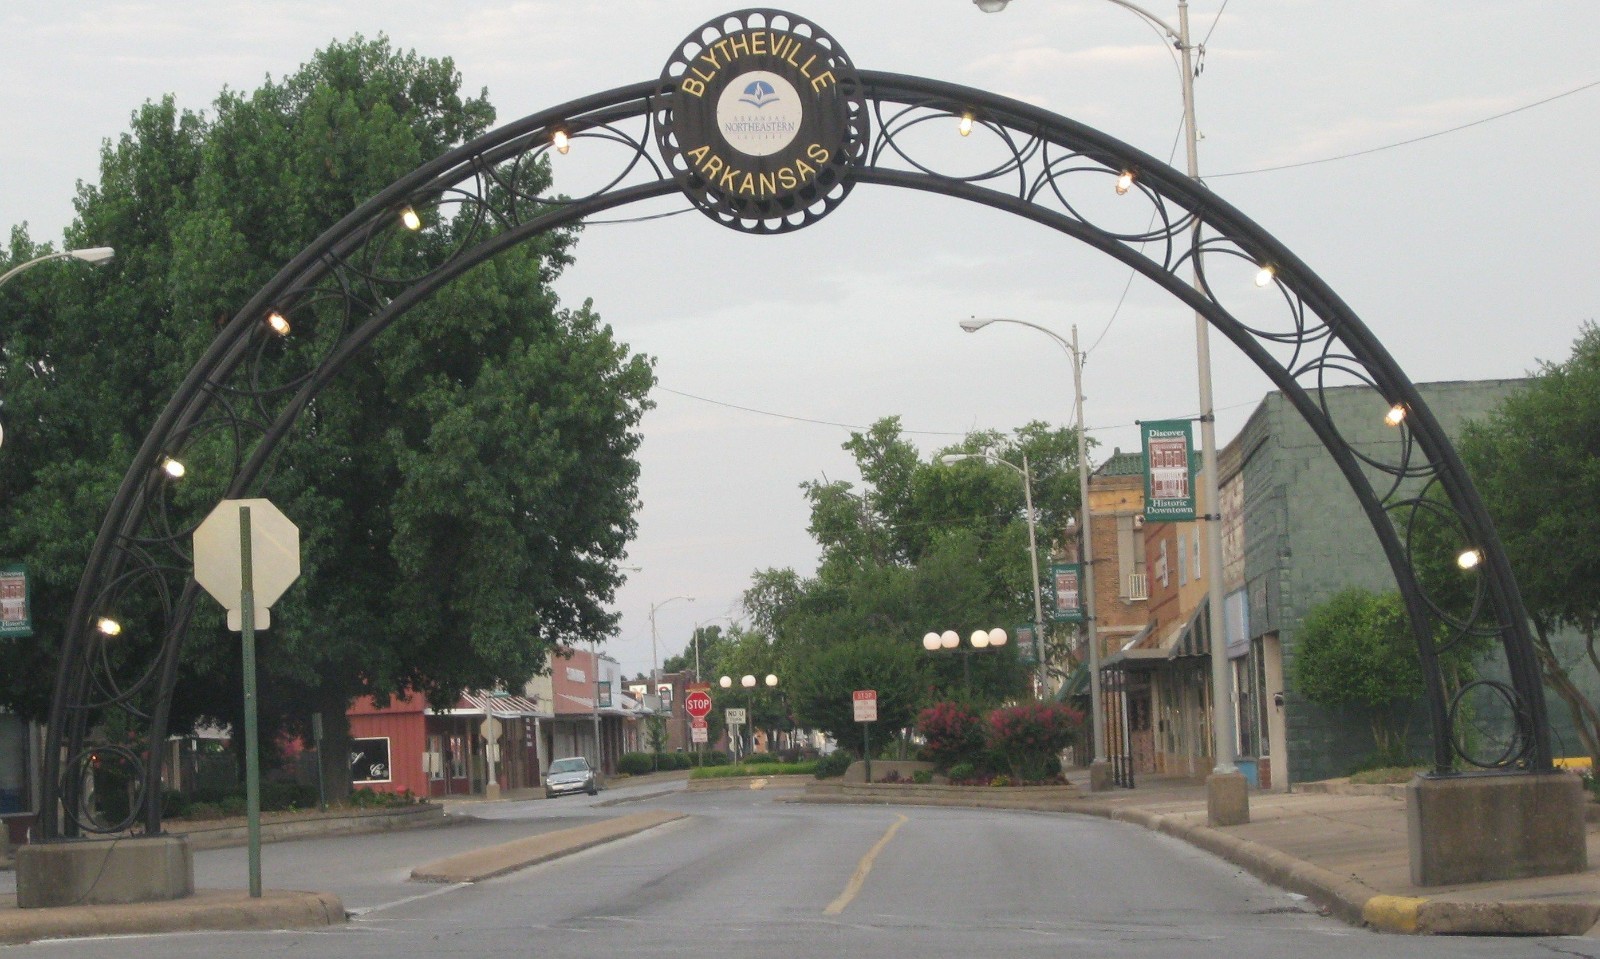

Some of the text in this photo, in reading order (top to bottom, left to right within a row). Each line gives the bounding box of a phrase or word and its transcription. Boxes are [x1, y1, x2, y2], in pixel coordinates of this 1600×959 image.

[681, 31, 836, 98] BLYTHEVILLE
[725, 121, 795, 132] NORTHEASTERN
[687, 143, 830, 195] ARKANSAS
[1149, 429, 1185, 437] Discover
[1152, 499, 1187, 507] Historic
[1147, 506, 1193, 514] Downtown
[687, 699, 710, 710] STOP
